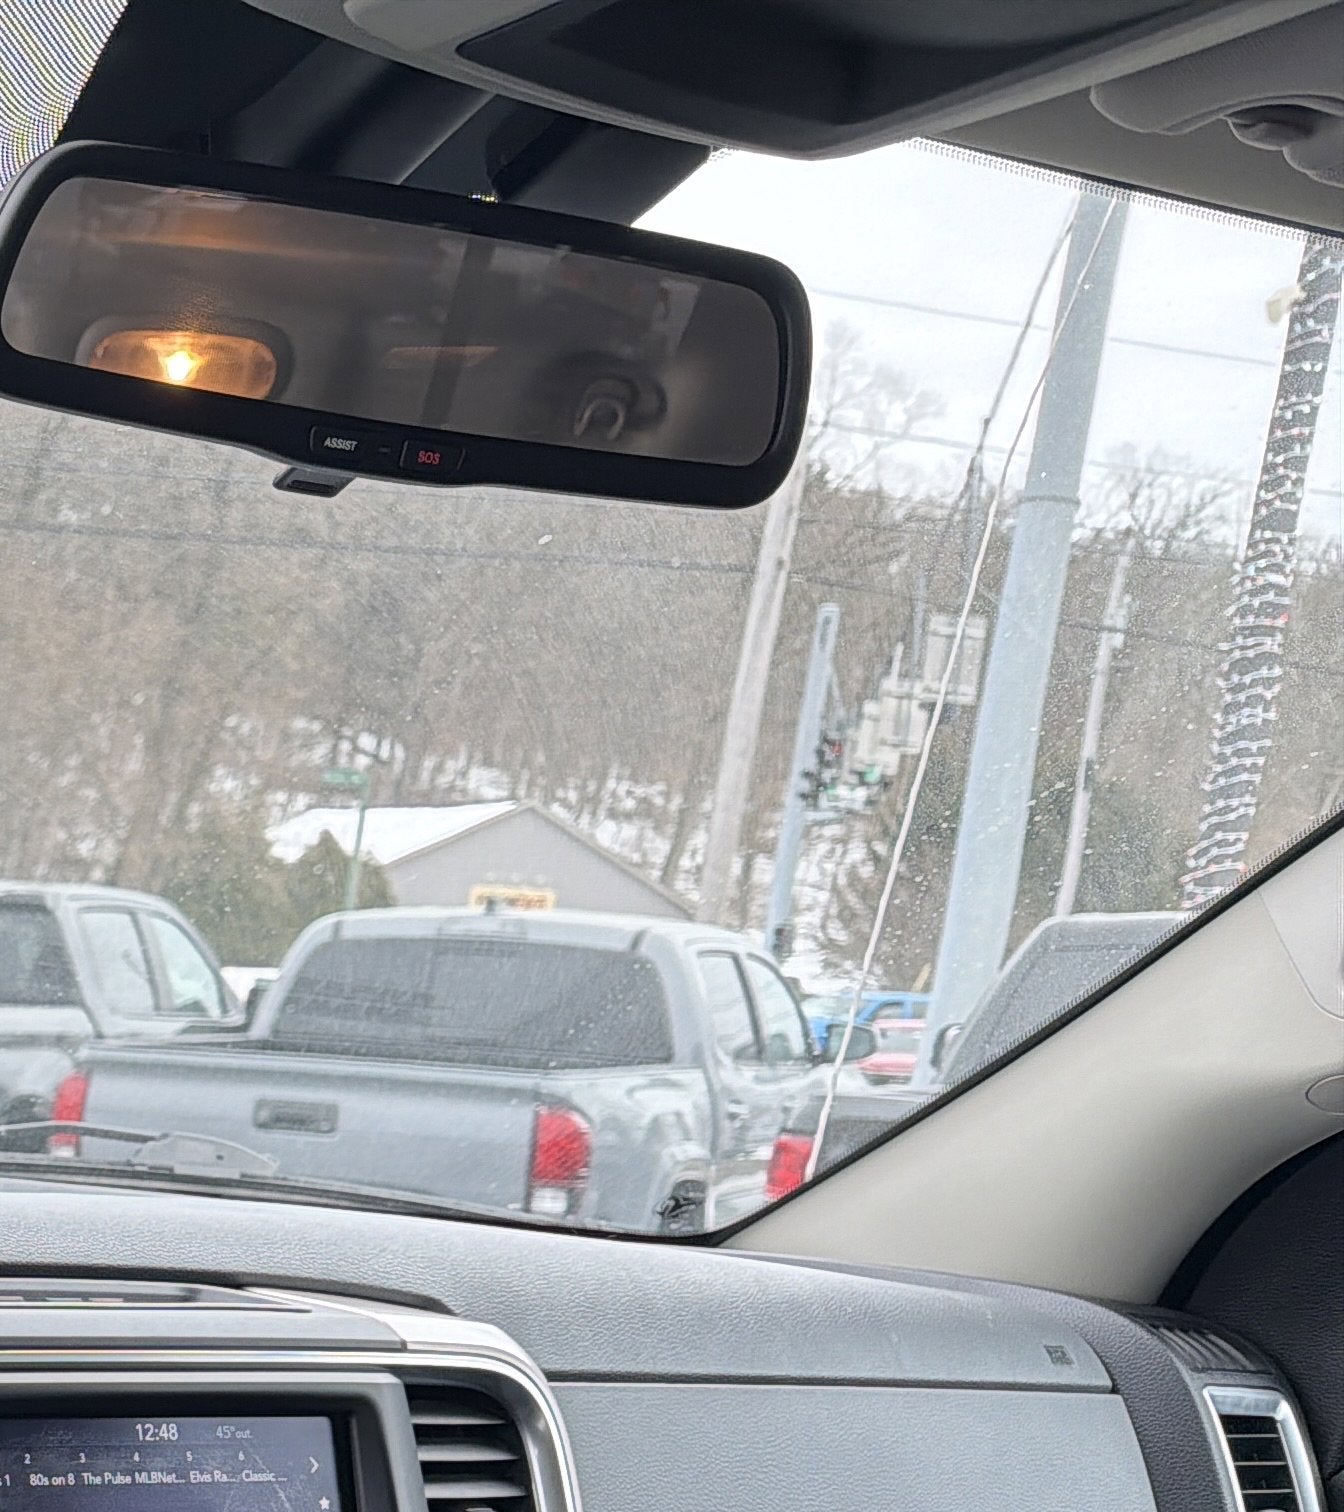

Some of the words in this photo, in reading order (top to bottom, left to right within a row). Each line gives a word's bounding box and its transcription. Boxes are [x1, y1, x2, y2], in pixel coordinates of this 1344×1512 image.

[323, 436, 358, 451] ASSIST
[417, 451, 441, 464] SOS
[135, 1423, 179, 1441] 12:48
[24, 1454, 31, 1464] 2
[79, 1453, 86, 1463] 3
[133, 1452, 140, 1462] 4
[186, 1451, 193, 1462] 5
[238, 1450, 245, 1461] 6
[4, 1474, 11, 1486] 1
[29, 1473, 49, 1486] 80s
[51, 1476, 65, 1486] on
[67, 1473, 75, 1485] 8
[81, 1472, 102, 1485] The
[104, 1472, 132, 1485] Pulse
[189, 1471, 212, 1484] Elvis
[241, 1469, 276, 1482] Classic
